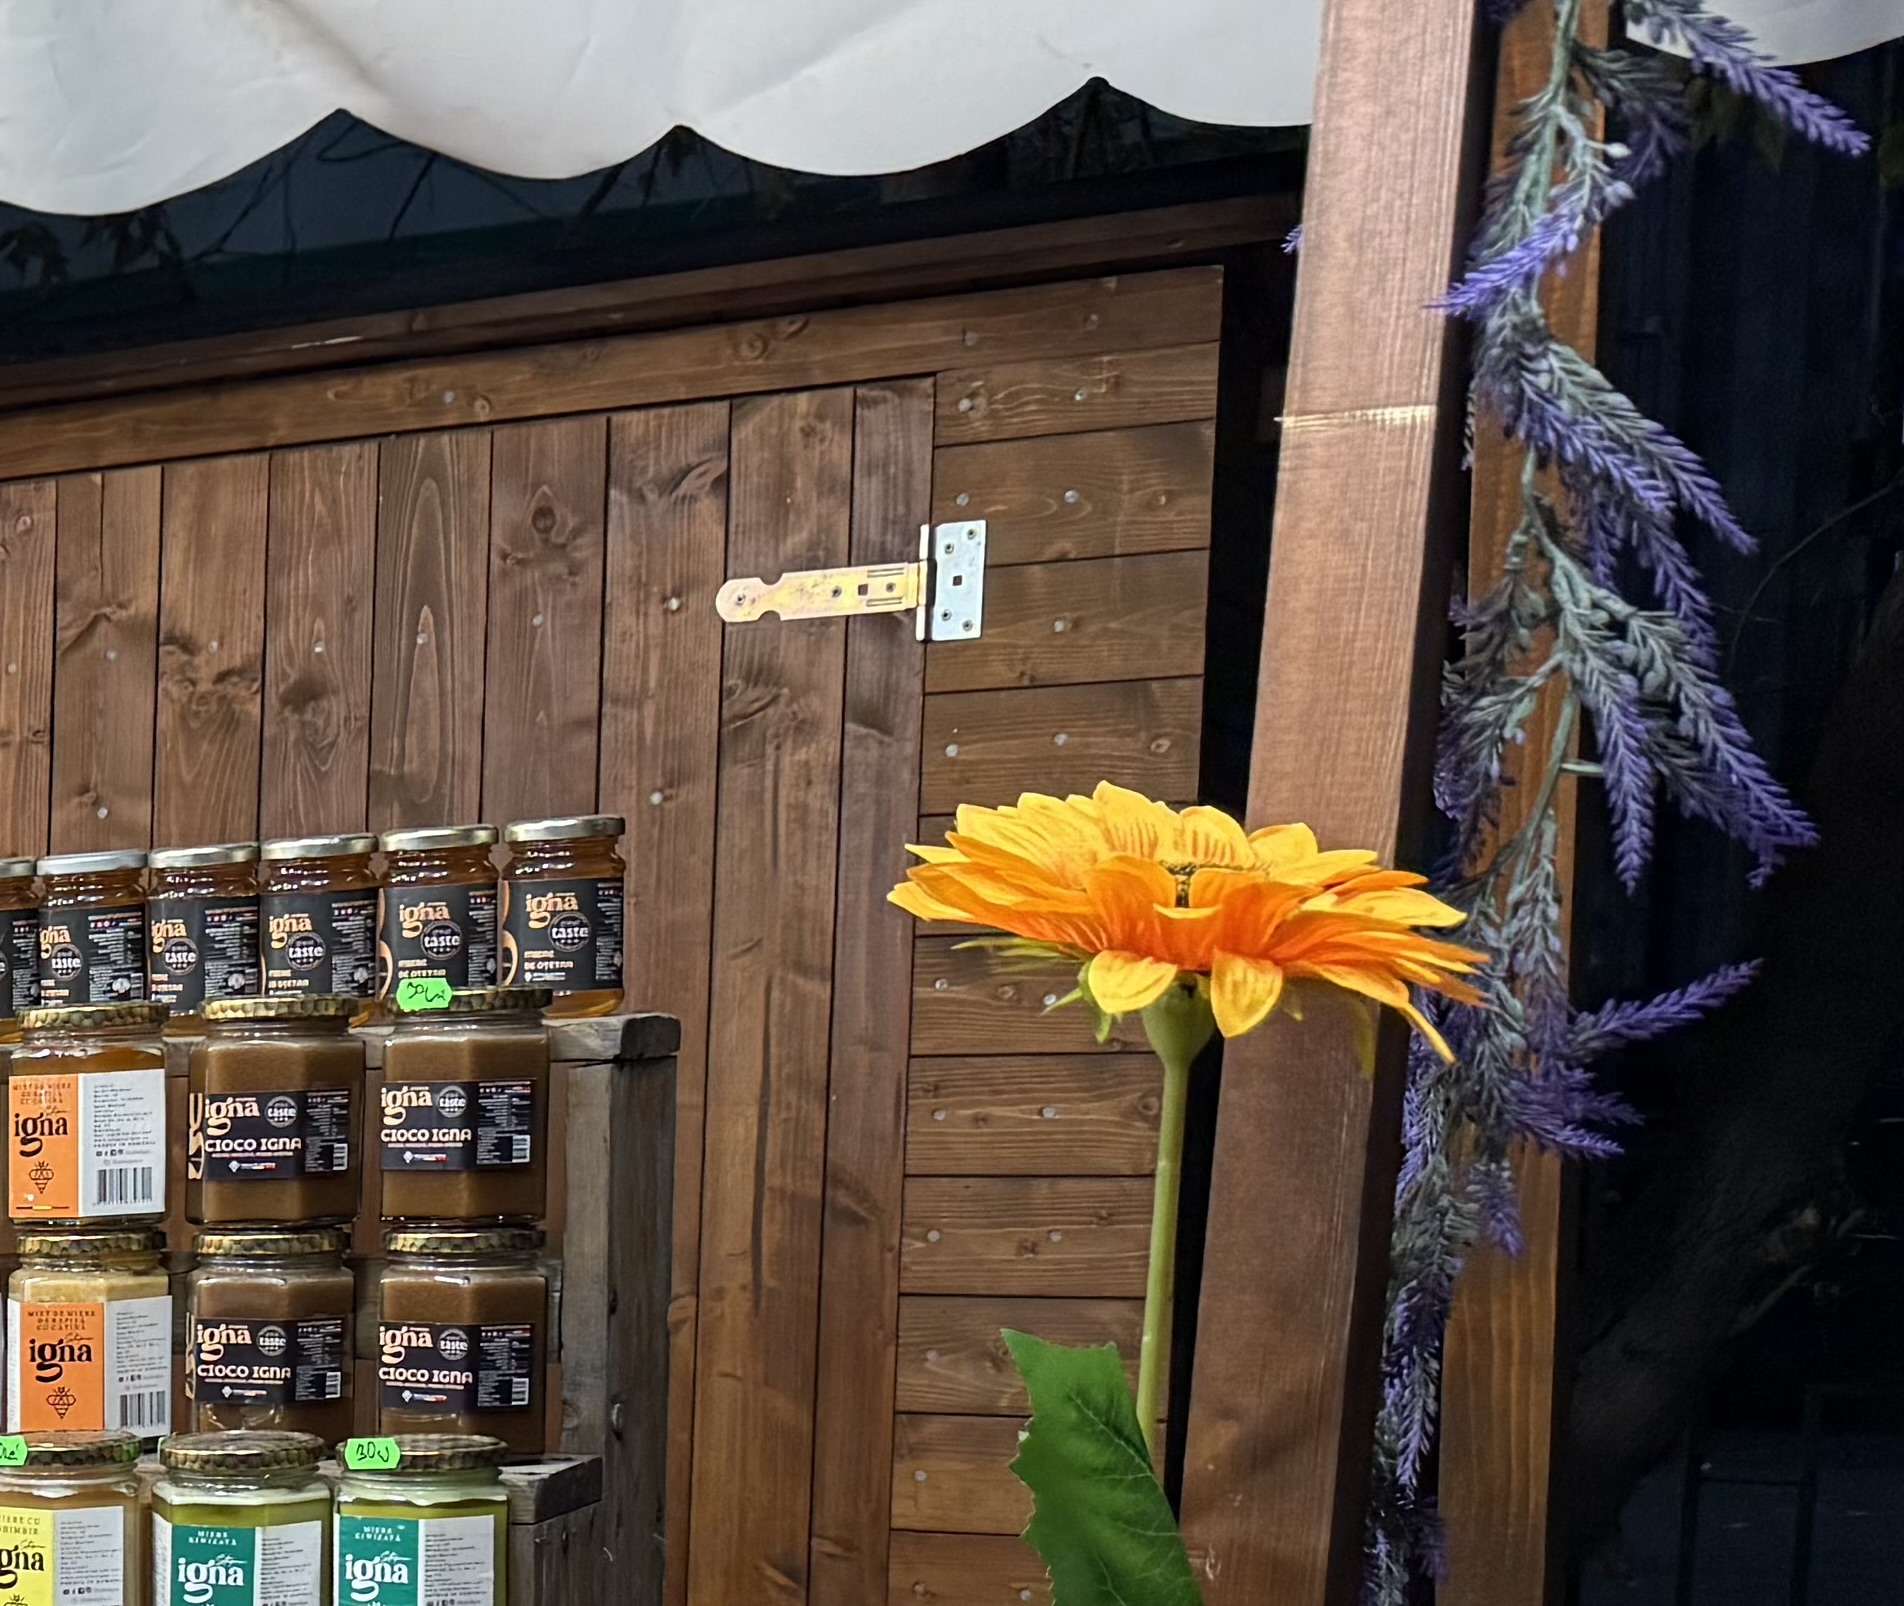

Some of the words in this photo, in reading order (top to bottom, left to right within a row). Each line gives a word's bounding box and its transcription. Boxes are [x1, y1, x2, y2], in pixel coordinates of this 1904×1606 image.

[399, 903, 450, 938] igna
[525, 893, 578, 928] igna
[269, 914, 312, 949] igna
[424, 933, 461, 949] taste
[552, 925, 589, 939] taste
[289, 944, 324, 958] taste
[205, 1096, 260, 1136] igna
[14, 1113, 68, 1157] igna
[204, 1139, 256, 1151] CIOCO
[261, 1138, 301, 1150] IGNA
[381, 1129, 427, 1142] CIOCO
[432, 1129, 471, 1141] IGNA
[29, 1339, 92, 1382] igna
[198, 1365, 248, 1378] CIOCO
[253, 1366, 291, 1379] IGNA
[379, 1368, 428, 1380] CIOCO
[433, 1371, 472, 1384] IGNA
[178, 1558, 244, 1603] igna
[345, 1551, 408, 1602] igna
